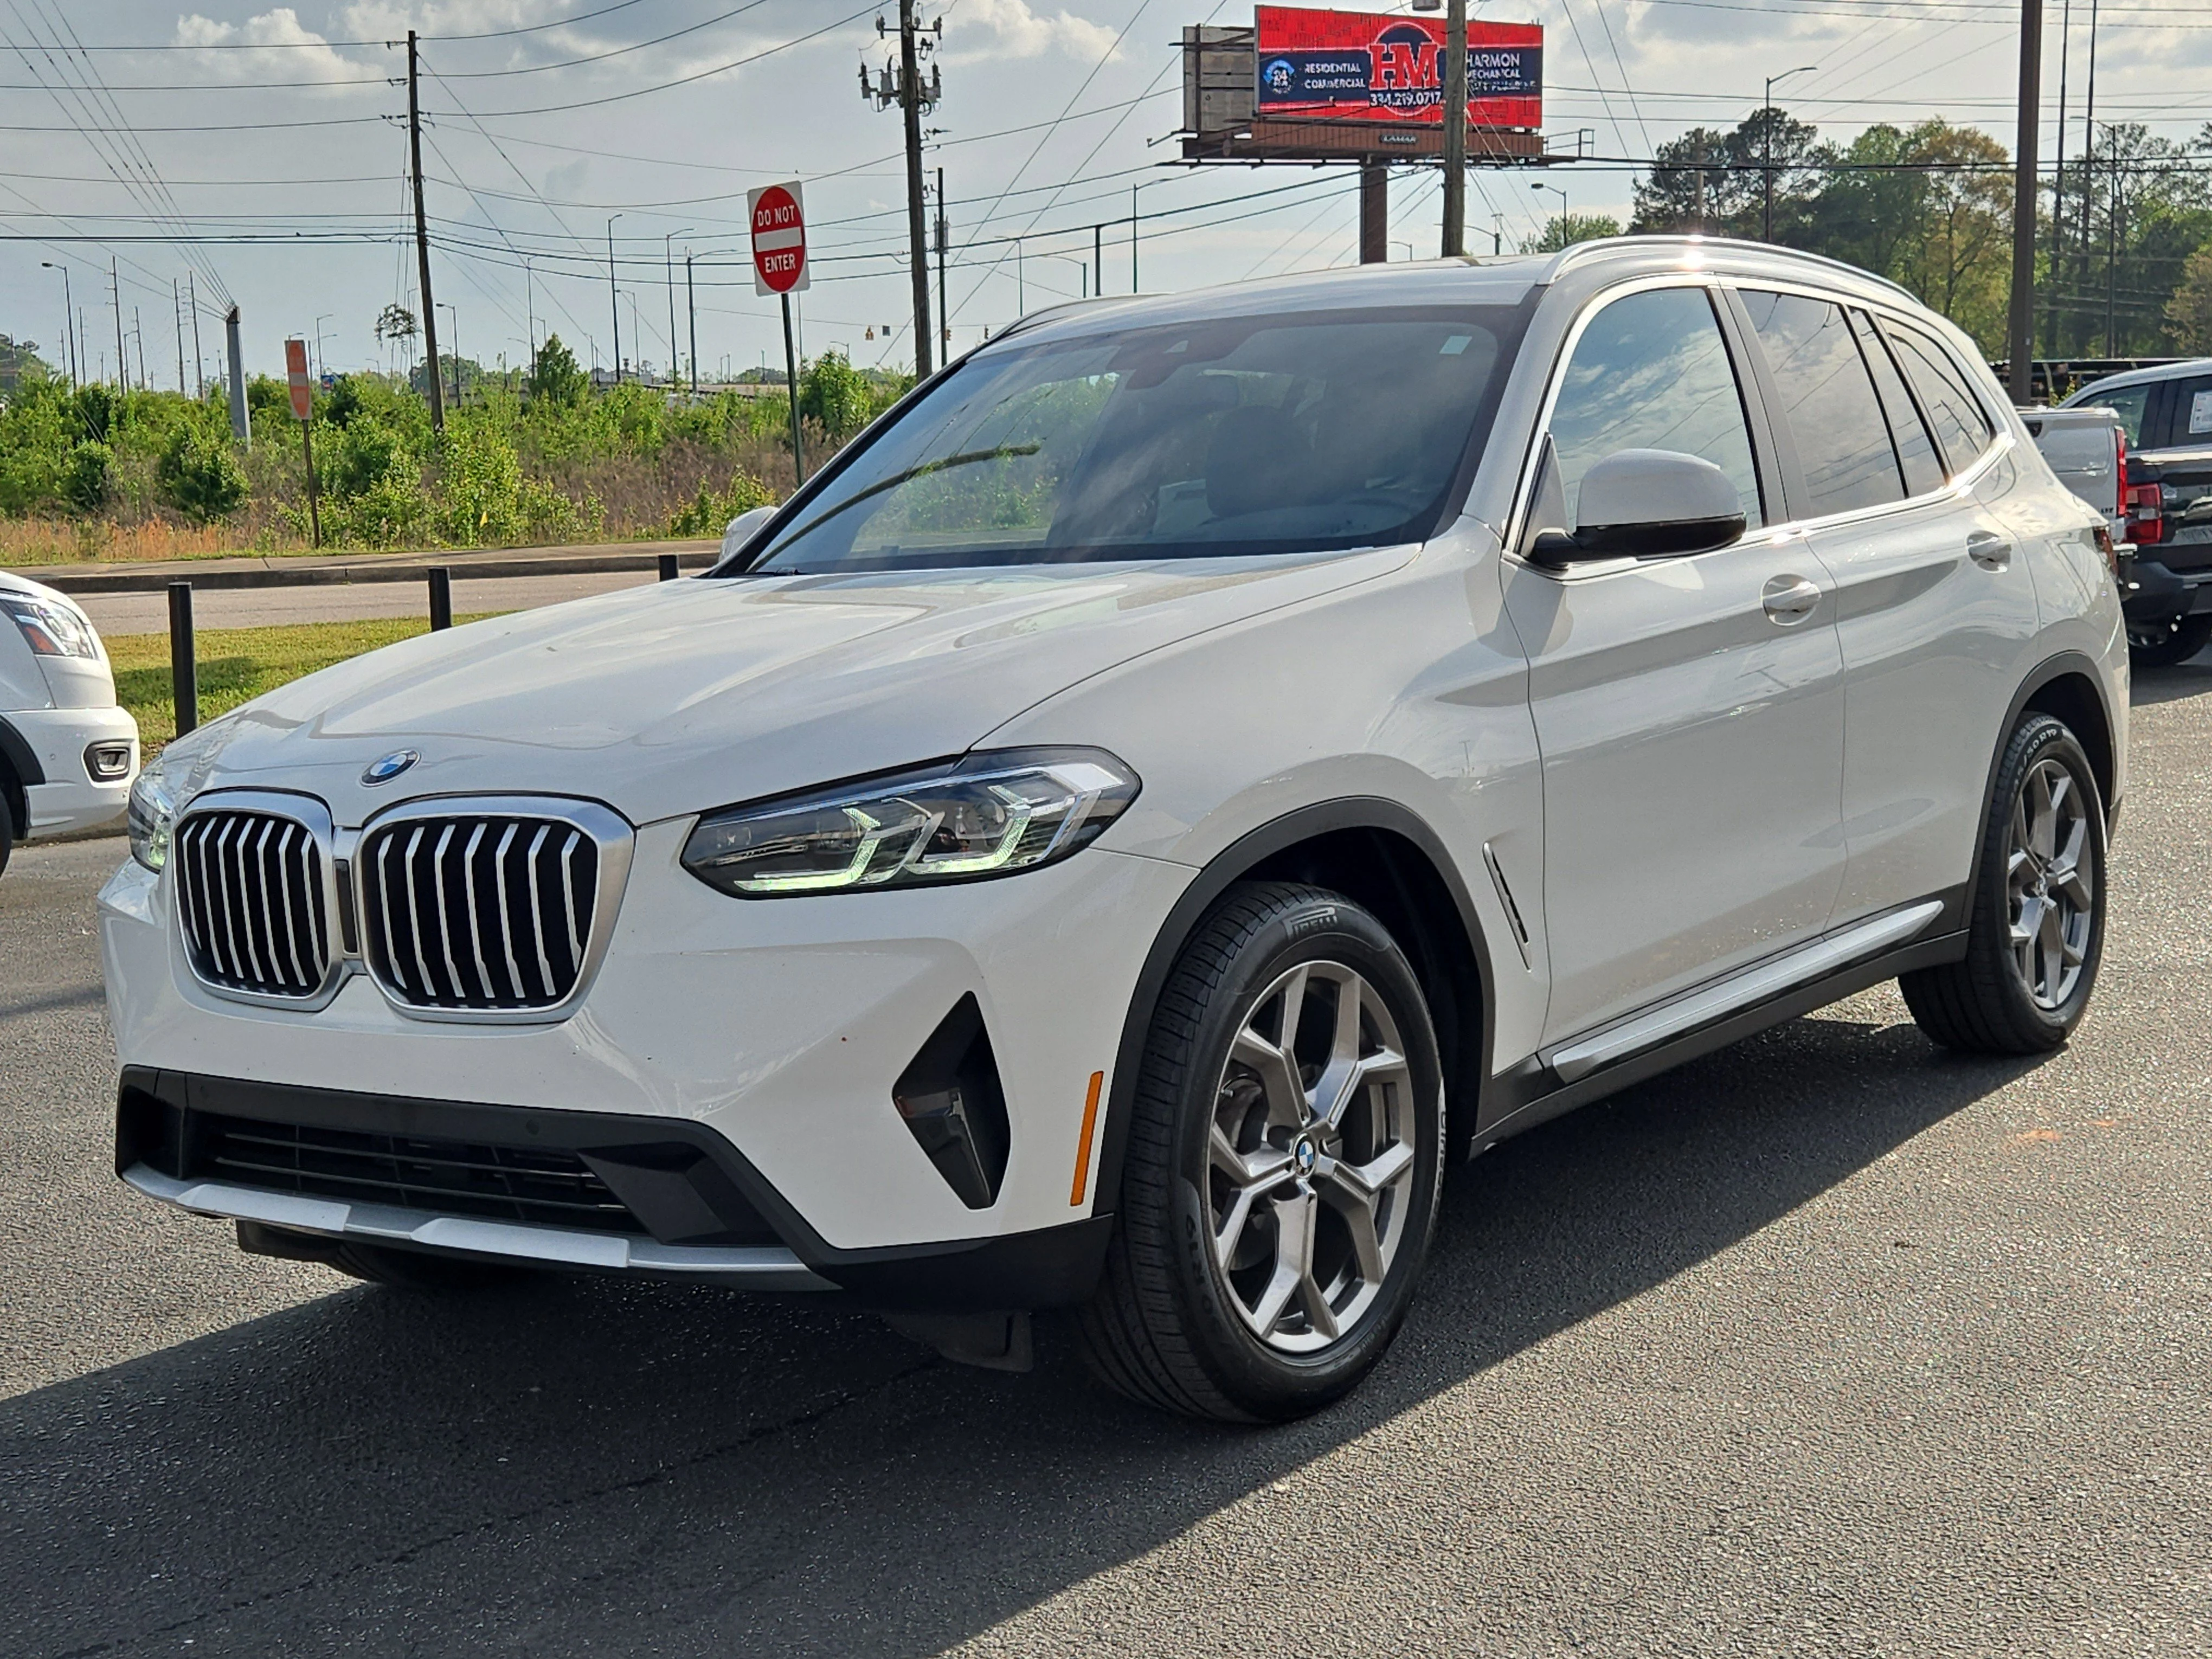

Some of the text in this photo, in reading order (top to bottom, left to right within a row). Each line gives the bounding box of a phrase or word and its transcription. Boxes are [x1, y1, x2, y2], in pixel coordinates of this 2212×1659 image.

[1304, 62, 1361, 74] RESIDENTIAL
[1367, 42, 1441, 90] HM
[1304, 78, 1366, 89] COMMERCIAL
[757, 204, 794, 227] DO NOT
[764, 253, 796, 273] ENTER
[1283, 906, 1338, 940] PIRELLI
